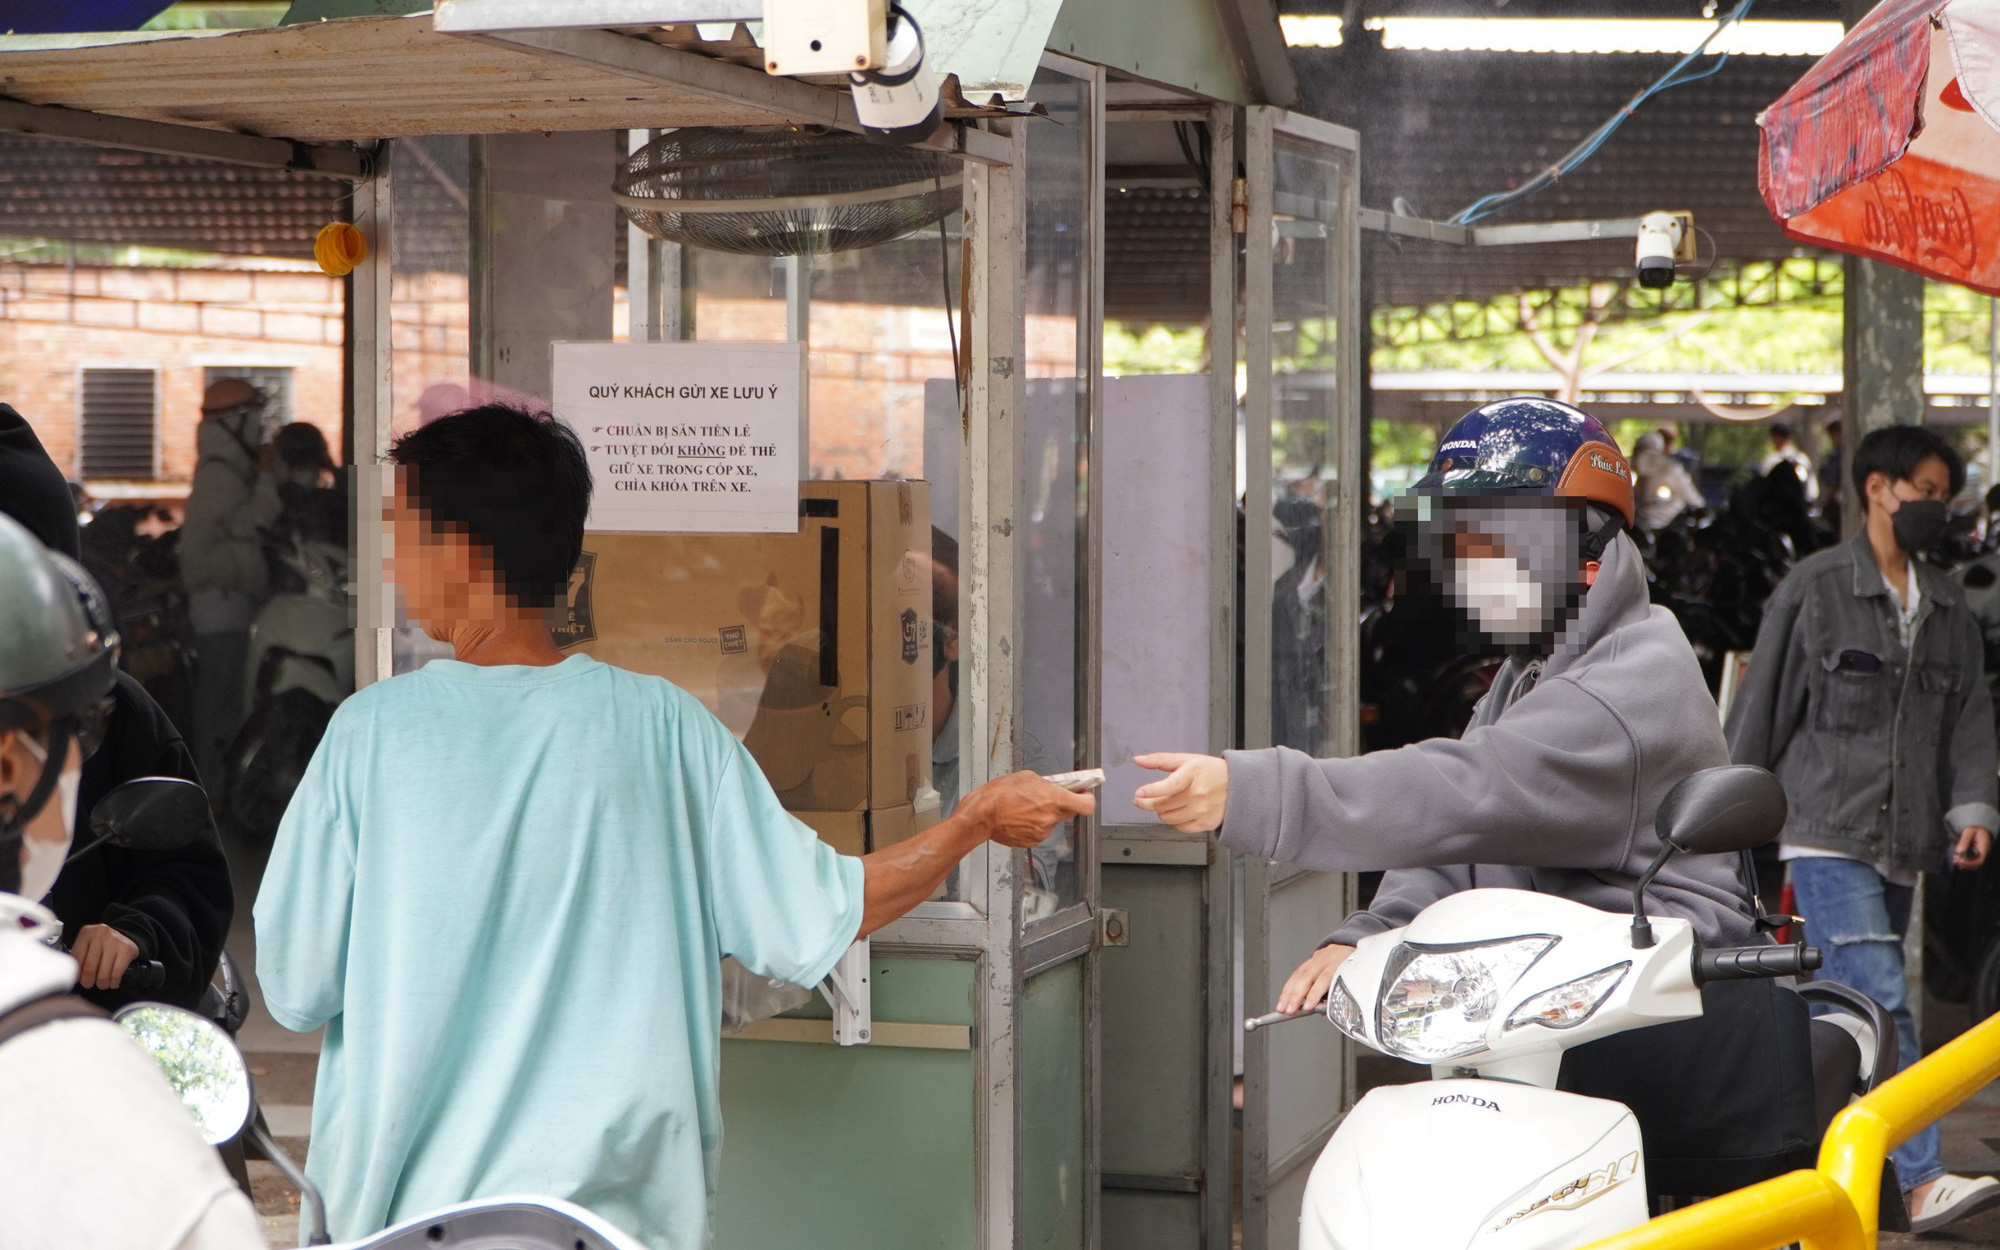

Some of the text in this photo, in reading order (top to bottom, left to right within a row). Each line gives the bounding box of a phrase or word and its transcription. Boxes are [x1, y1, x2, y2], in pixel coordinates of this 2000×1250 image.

[589, 383, 778, 399] QUÝ KHÁCH GỬI XE LƯU Ý
[656, 425, 668, 439] BỊ
[605, 443, 648, 458] TUYỆT
[677, 443, 726, 458] KHÔNG
[1440, 440, 1477, 452] HONDA
[609, 461, 635, 475] GIỮ
[637, 464, 654, 475] XE
[657, 464, 703, 475] TRONG
[736, 465, 758, 477] XE,
[614, 478, 751, 493] CHÌA KHÓA TRÊN XE.
[1431, 1094, 1502, 1112] HONDA
